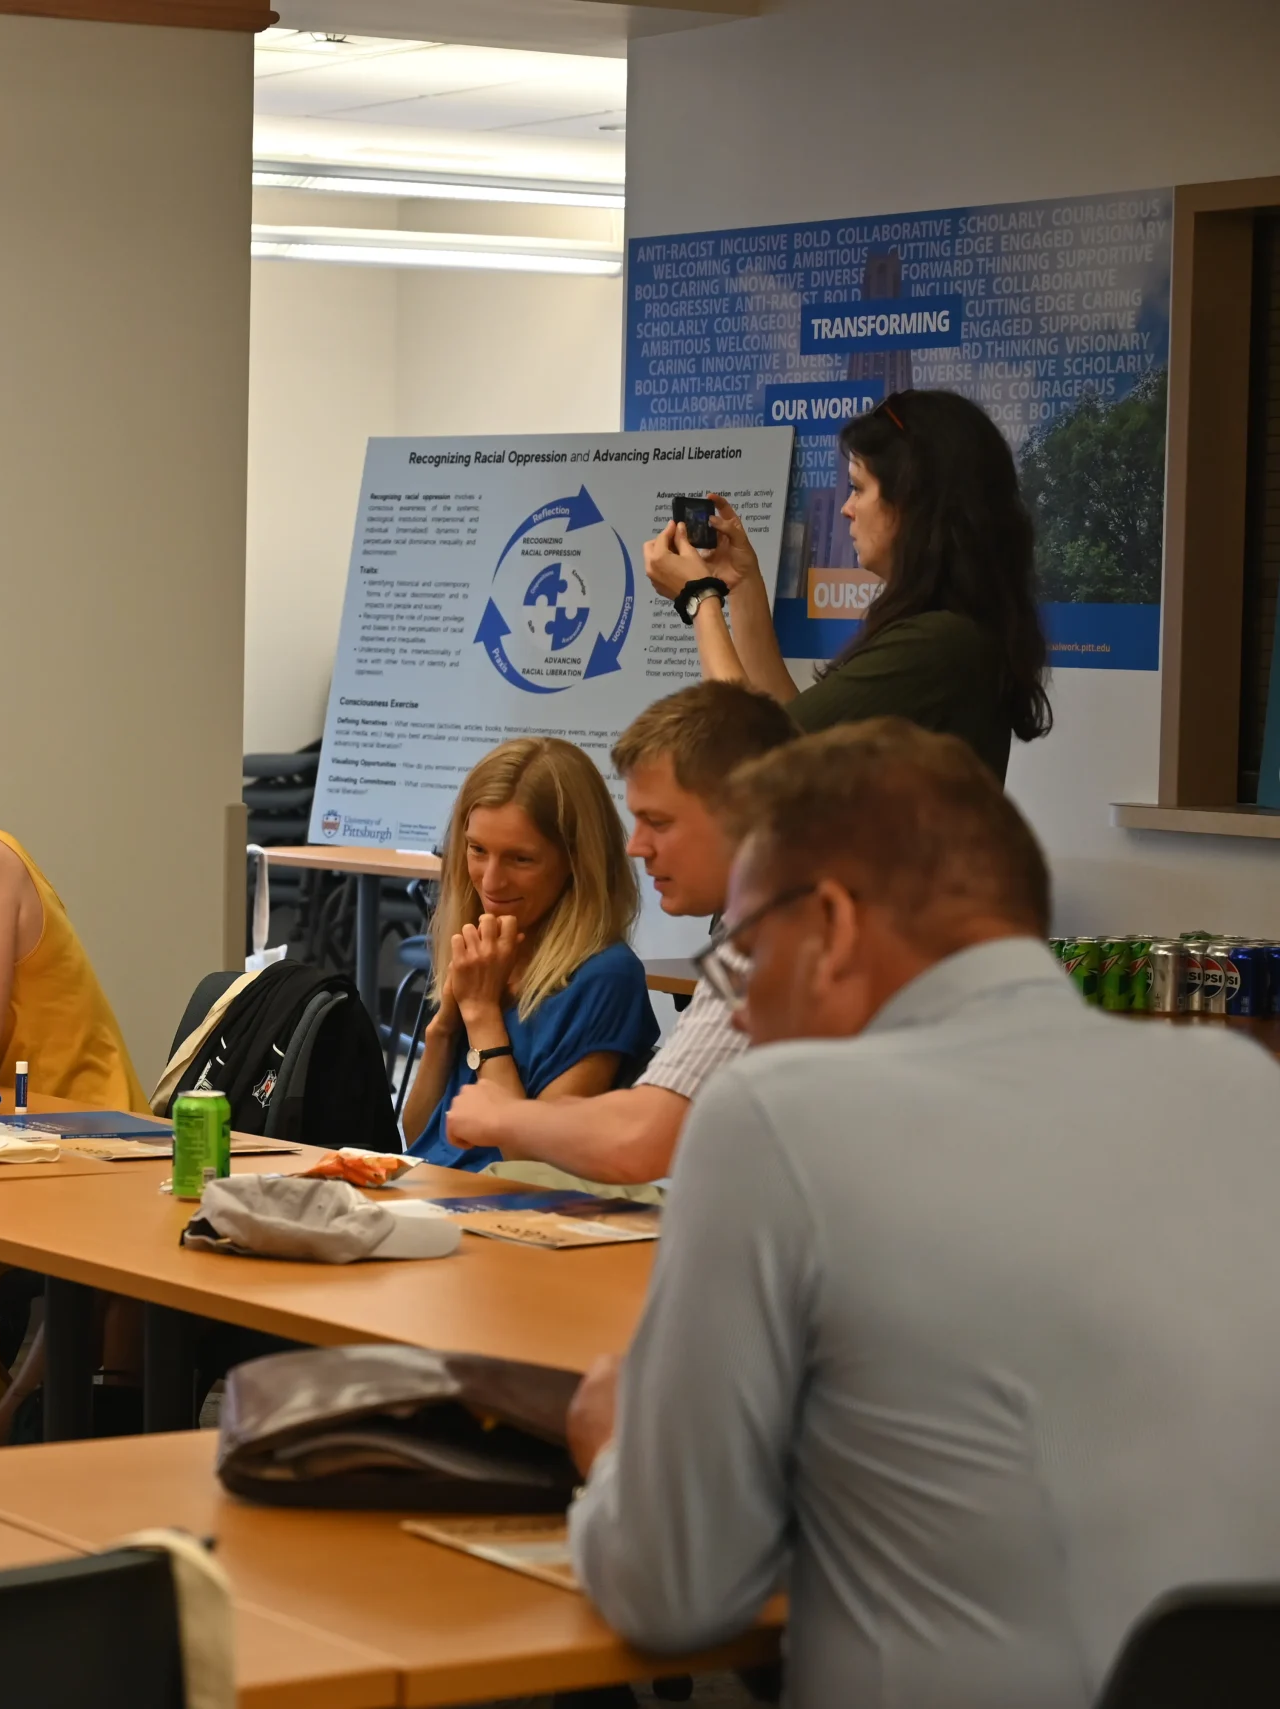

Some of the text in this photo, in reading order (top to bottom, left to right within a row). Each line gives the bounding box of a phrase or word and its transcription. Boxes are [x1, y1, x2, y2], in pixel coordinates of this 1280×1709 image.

[637, 199, 1160, 263] ANTI-RACIST INCLUSIVE BOLD COLLABORATIVE SCHOLARLY COURAGEOUS
[653, 258, 730, 280] WELCOMING
[736, 254, 787, 274] CARING
[792, 246, 868, 269] AMBITIOUS
[955, 236, 994, 256] EDGE
[1001, 229, 1074, 252] ENGAGED
[1081, 220, 1167, 245] VISIONARY
[634, 283, 668, 301] BOLD
[671, 279, 719, 297] CARING
[725, 272, 804, 294] INNOVATIVE
[901, 258, 973, 281] FORWARD
[976, 252, 1049, 275] THINKING
[1056, 244, 1154, 269] SUPPORTIVE
[644, 297, 729, 318] PROGRESSIVE
[735, 291, 817, 313] ANTI-RACIST
[824, 288, 861, 304] BOLD
[993, 269, 1116, 295] COLLABORATIVE
[636, 318, 707, 339] SCHOLARLY
[965, 296, 1031, 318] CUTTING
[1034, 292, 1075, 312] EDGE
[1082, 288, 1142, 310] CARING
[811, 310, 950, 340] TRANSFORMING
[641, 310, 1136, 358] AMBITIOUS WELCOMING ENGAGED SUPPORTIVE
[649, 357, 696, 376] CARING
[701, 352, 781, 373] INNOVATIVE
[786, 352, 842, 370] DIVERSE
[985, 336, 1058, 359] THINKING
[1065, 332, 1151, 355] VISIONARY
[634, 378, 668, 396] BOLD
[671, 374, 750, 394] ANTI-RACIST
[912, 363, 971, 384] DIVERSE
[979, 358, 1056, 380] INCLUSIVE
[1063, 353, 1154, 376] SCHOLARLY
[650, 377, 1115, 414] COLLABORATIVE COURAGEOUS
[639, 415, 709, 432] AMBITIOUS
[714, 412, 764, 430] CARING
[772, 400, 808, 420] OUR
[409, 446, 742, 467] Recognizing Racial Oppression and Advancing Racial Liberation
[734, 489, 751, 497] entails
[753, 489, 774, 498] actively
[792, 471, 837, 488] VATIVE
[532, 505, 570, 523] Reflection
[745, 514, 771, 522] empower
[612, 596, 633, 642] Education
[492, 648, 509, 674] Praxis
[544, 657, 582, 665] ADVANCING
[546, 669, 582, 677] LIBERATION
[342, 824, 392, 843] Pittsburgh
